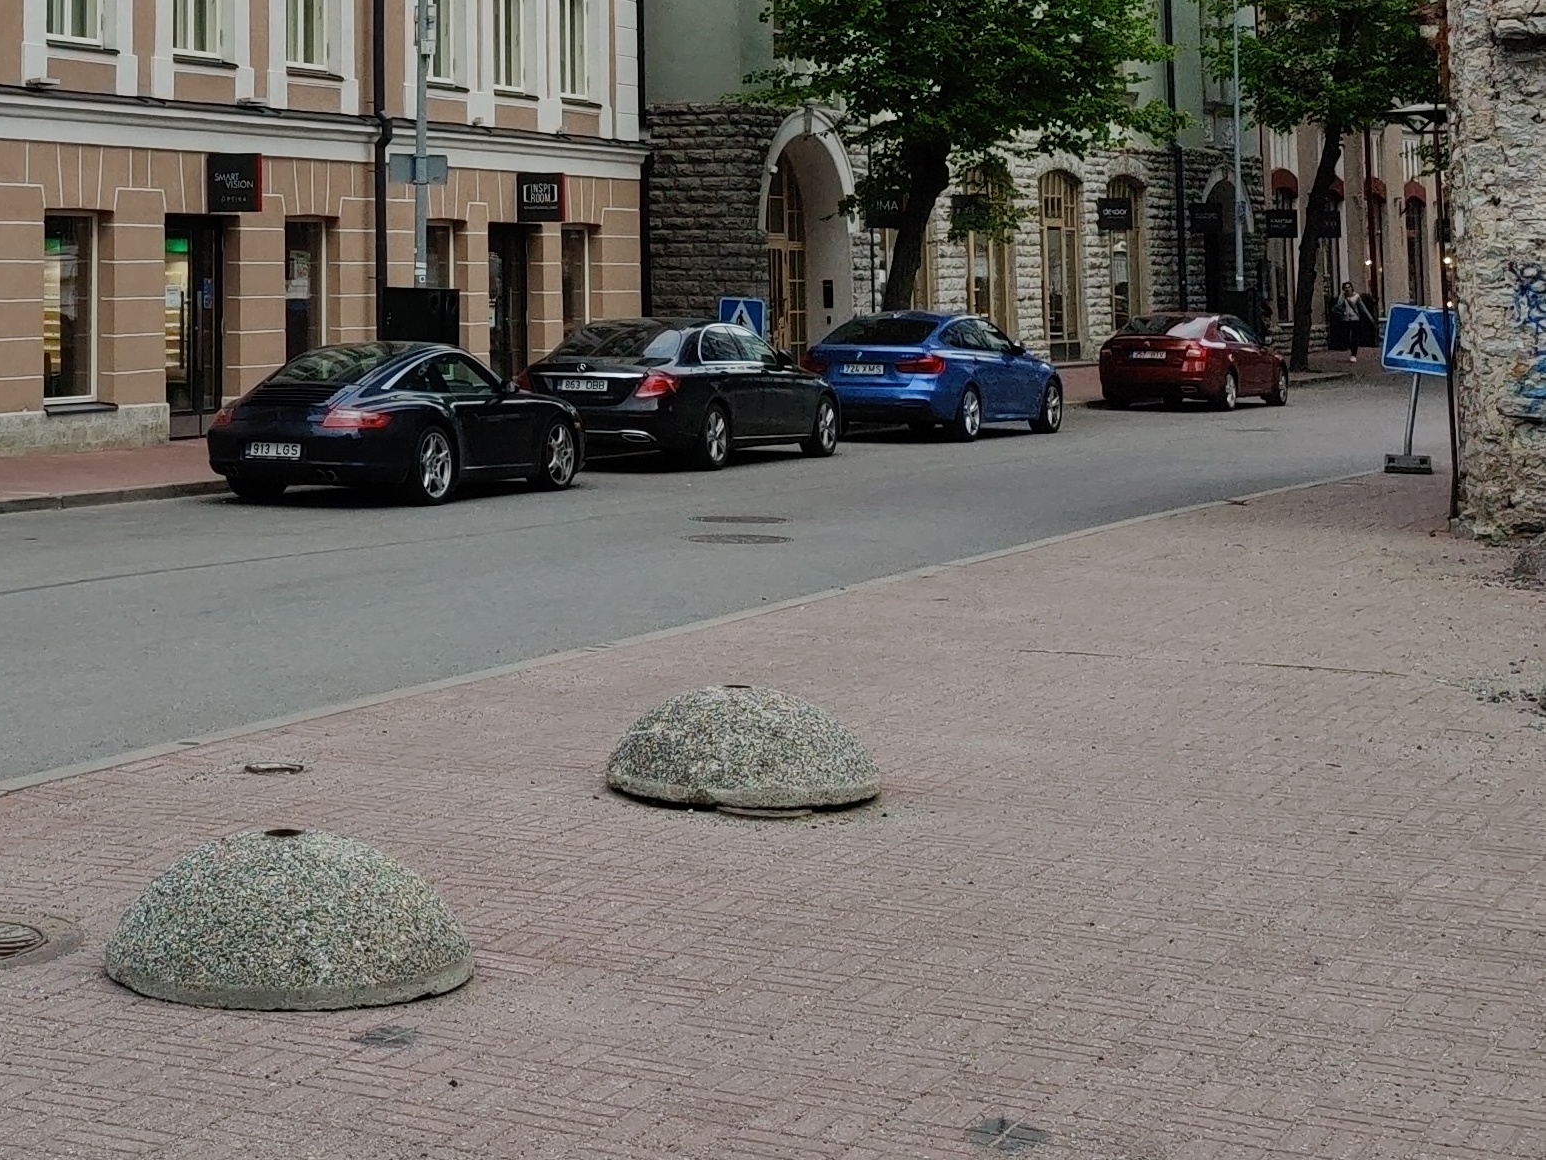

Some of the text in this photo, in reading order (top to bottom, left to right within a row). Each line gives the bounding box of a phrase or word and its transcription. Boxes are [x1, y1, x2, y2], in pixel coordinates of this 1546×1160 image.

[214, 172, 240, 182] SMART
[225, 179, 254, 189] VISION
[530, 193, 551, 203] ROOM
[253, 443, 299, 456] 913 LGS
